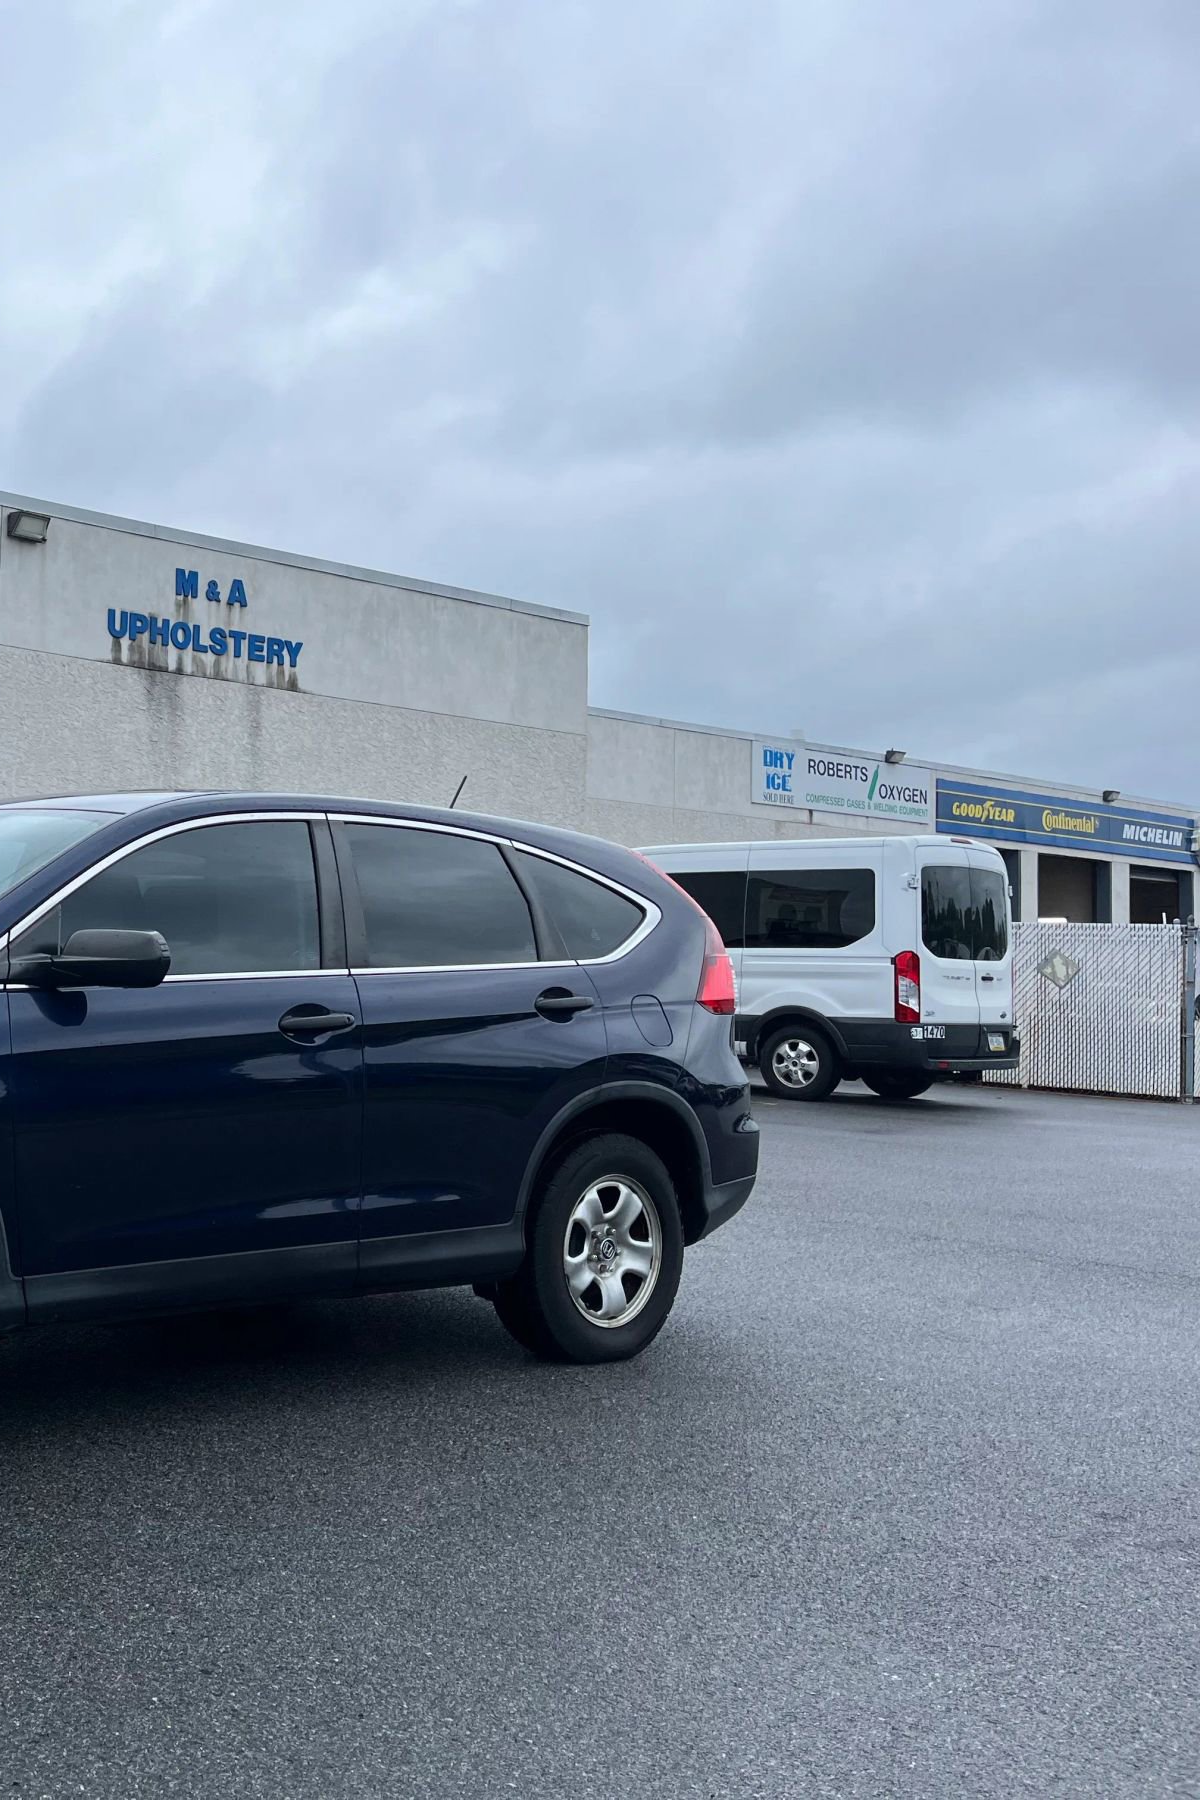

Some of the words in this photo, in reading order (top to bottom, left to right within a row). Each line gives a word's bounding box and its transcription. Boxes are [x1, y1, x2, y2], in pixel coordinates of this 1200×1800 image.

[176, 568, 198, 598] M
[206, 580, 220, 602] &
[226, 578, 248, 608] A
[107, 608, 303, 668] UPHOLSTERY
[762, 746, 795, 770] DRY
[808, 758, 868, 782] ROBERTS
[766, 772, 792, 792] ICE
[879, 784, 927, 804] OXYGEN
[762, 791, 778, 803] SOLD
[778, 793, 795, 806] HERE
[805, 792, 845, 807] COMPRESSED
[846, 797, 866, 810] GASES
[873, 802, 898, 814] WELDING
[899, 806, 928, 818] EQUIPMENT
[952, 801, 1015, 823] GOODYEAR
[1042, 809, 1095, 834] Continental
[1122, 823, 1183, 847] MICHELIN
[924, 1026, 945, 1038] 1470
